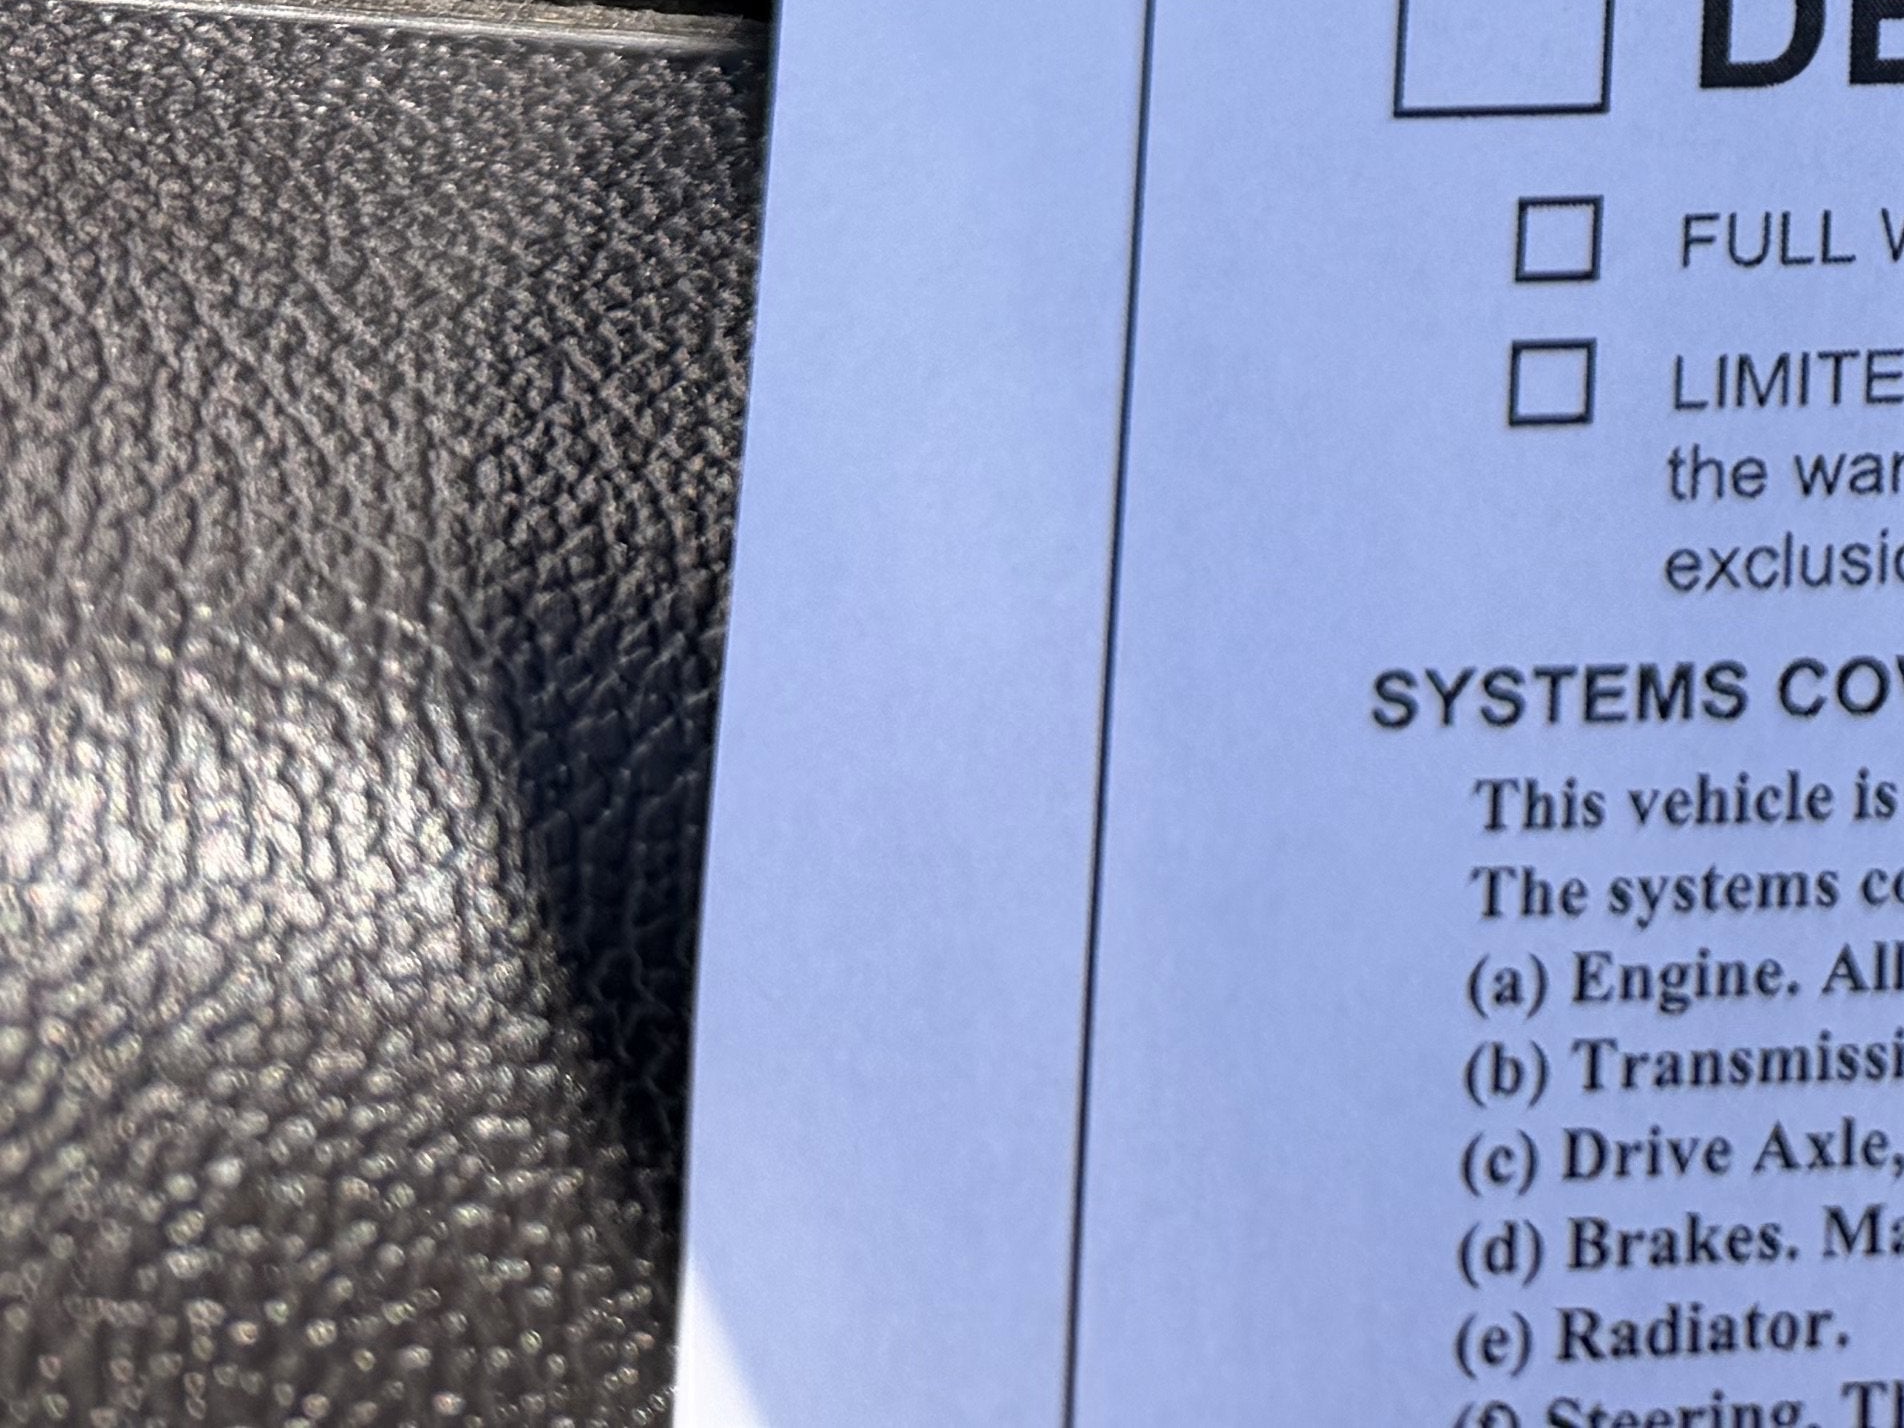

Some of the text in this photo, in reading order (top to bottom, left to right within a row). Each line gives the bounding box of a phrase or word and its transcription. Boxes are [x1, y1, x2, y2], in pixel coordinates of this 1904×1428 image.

[1681, 209, 1856, 269] FULL
[1371, 660, 1749, 732] SYSTEMS
[1473, 777, 1605, 834] This
[1628, 770, 1834, 829] vehicle
[1853, 767, 1897, 823] is
[1467, 954, 1549, 1020] (a)
[1572, 947, 1800, 1017] Engine.
[1457, 1220, 1544, 1289] (d)
[1567, 1212, 1799, 1272] Brakes.
[1454, 1301, 1850, 1380] (e) Radiator.
